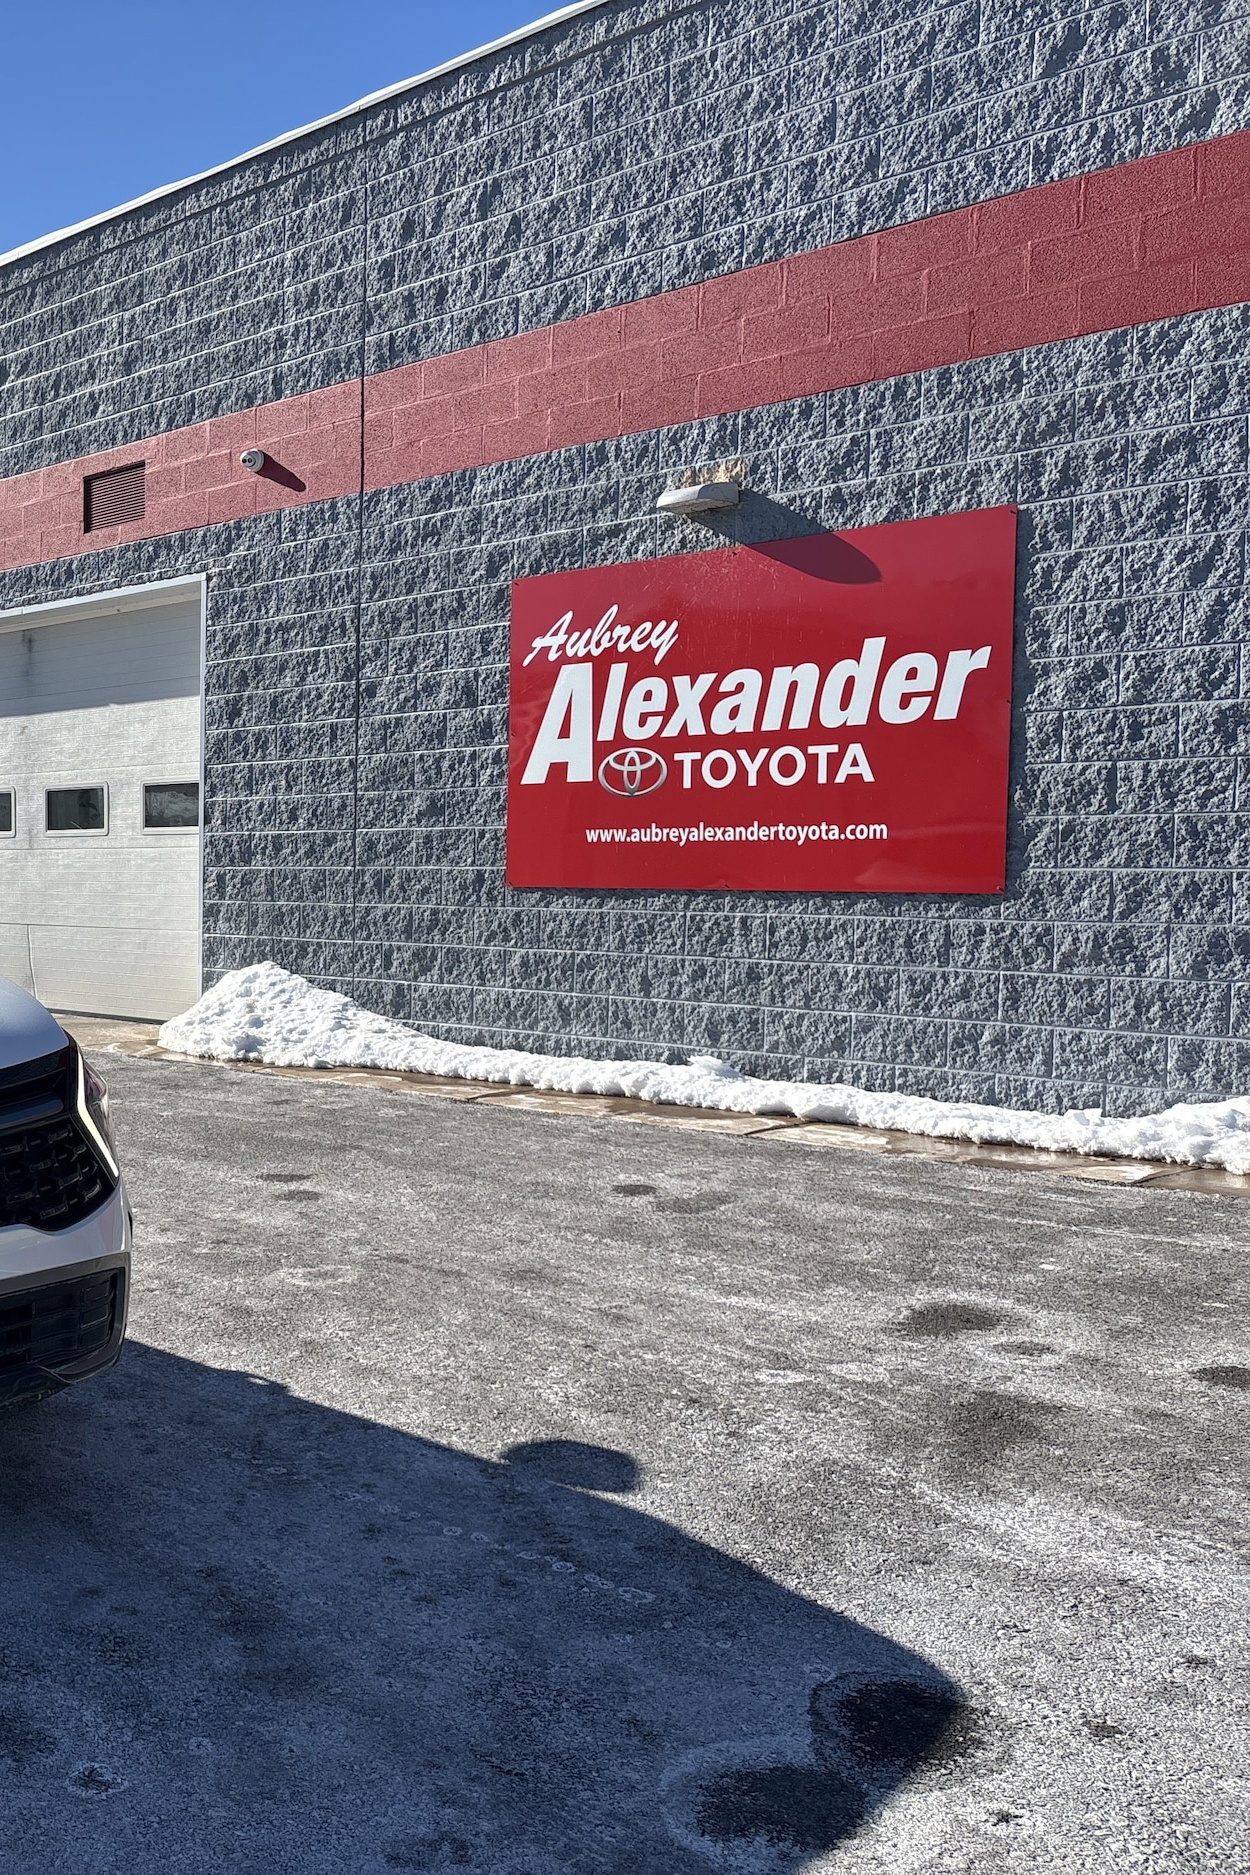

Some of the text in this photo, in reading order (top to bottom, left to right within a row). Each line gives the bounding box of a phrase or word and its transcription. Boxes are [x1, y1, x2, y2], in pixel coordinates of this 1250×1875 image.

[522, 604, 679, 667] Aubrey
[520, 636, 992, 785] Alexander
[674, 743, 876, 789] TOYOTA
[585, 820, 888, 847] www.aubreyalexandertoyota.com
